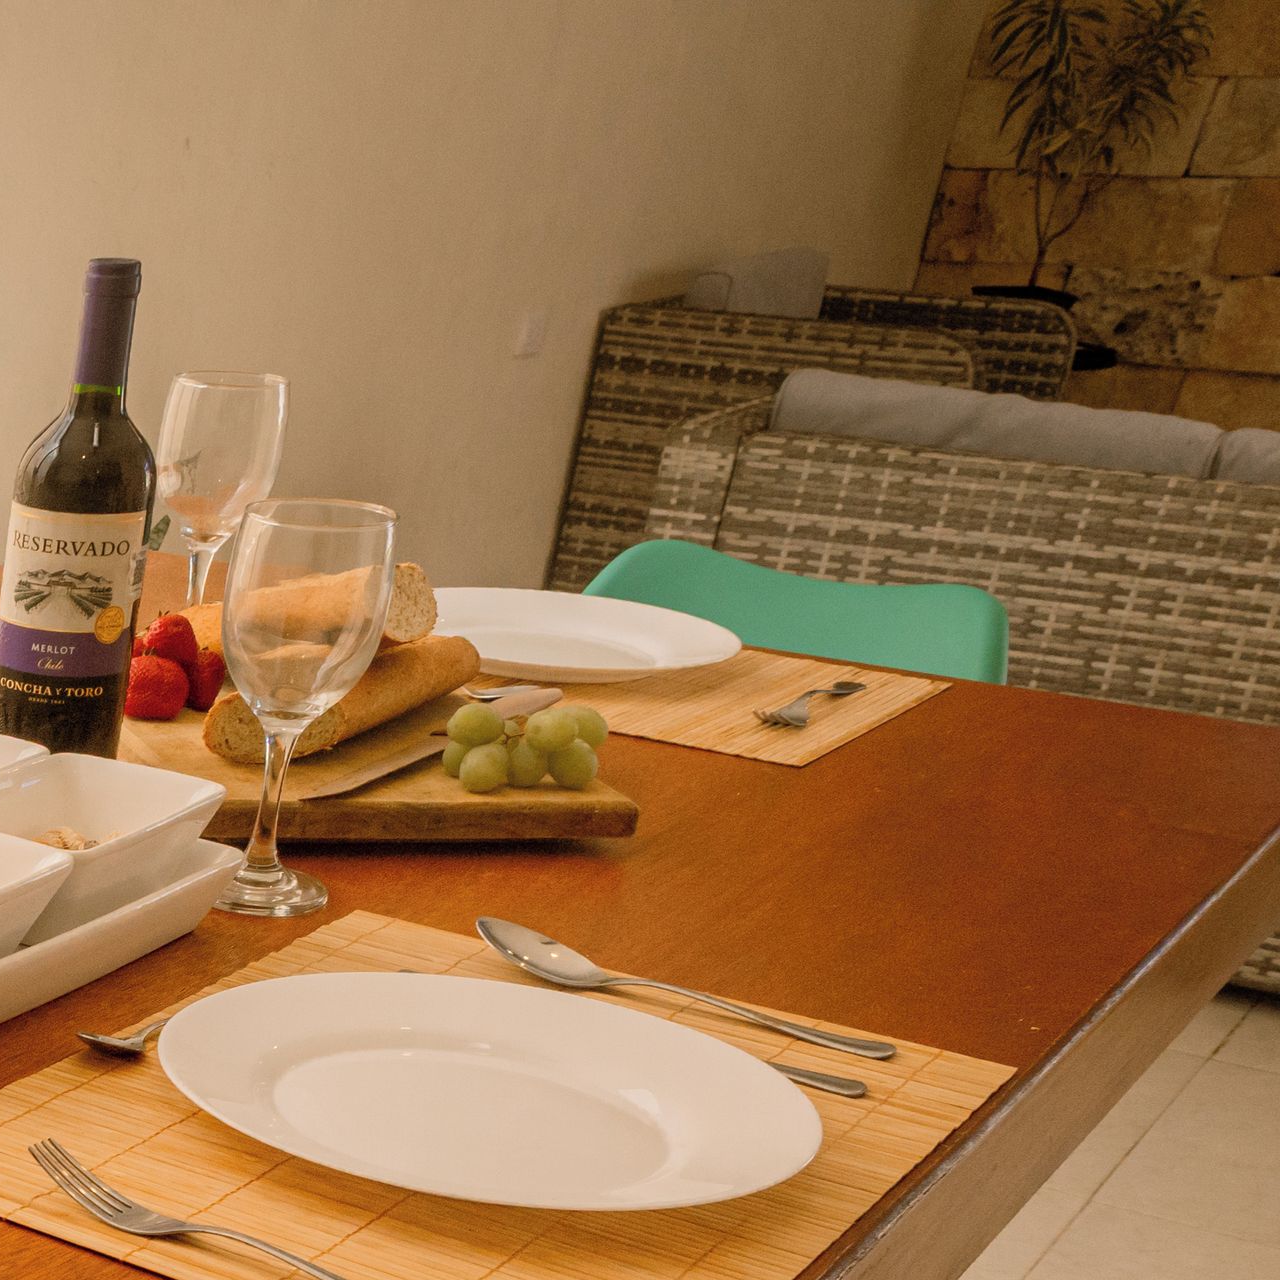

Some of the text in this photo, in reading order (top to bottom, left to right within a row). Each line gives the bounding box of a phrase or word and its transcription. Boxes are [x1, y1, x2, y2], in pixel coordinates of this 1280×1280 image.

[13, 530, 131, 557] RESERVADO
[31, 643, 76, 655] MERLOT
[37, 656, 65, 671] Chile
[0, 677, 104, 698] CONCHA Y TORO
